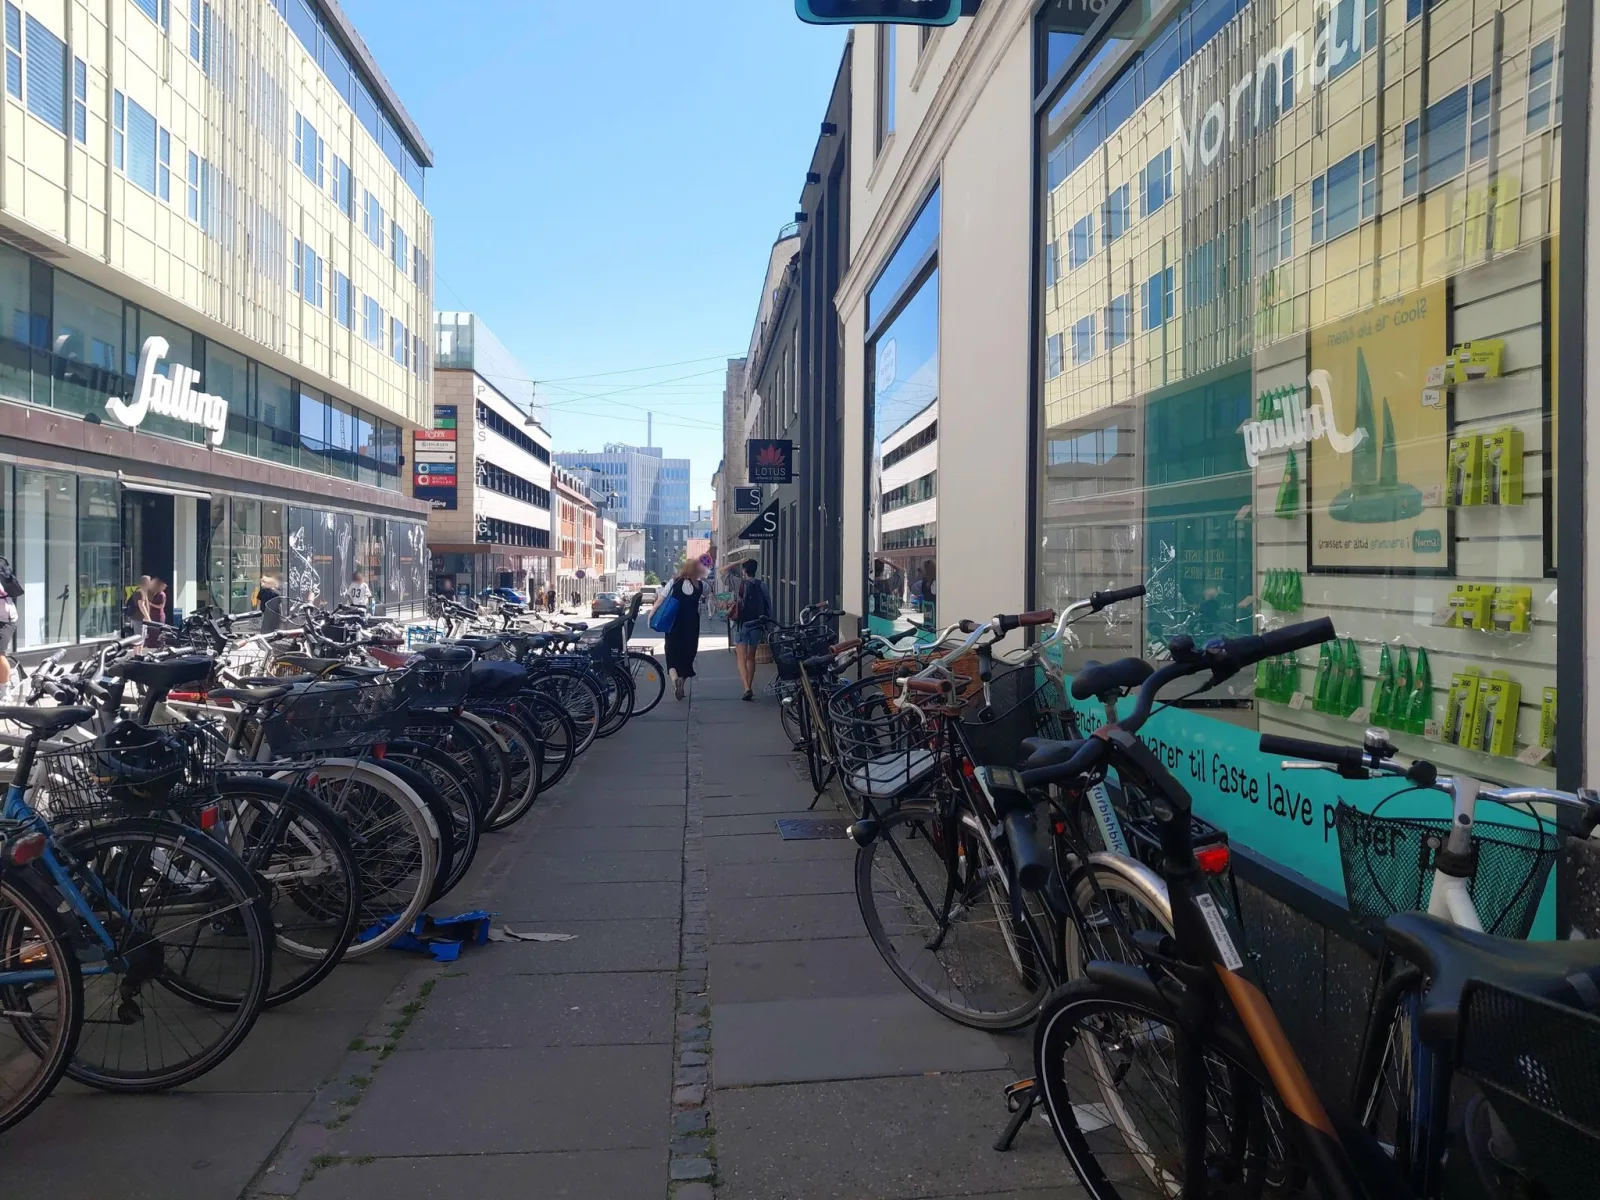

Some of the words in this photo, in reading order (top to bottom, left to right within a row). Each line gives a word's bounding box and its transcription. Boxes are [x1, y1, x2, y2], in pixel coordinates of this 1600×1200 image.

[1174, 0, 1365, 176] Normal
[1327, 326, 1354, 347] mens
[1375, 315, 1389, 332] er
[105, 336, 229, 446] Salling
[756, 467, 786, 476] LOTUS
[750, 489, 761, 506] S
[764, 512, 777, 532] S
[1353, 537, 1369, 550] altid
[1415, 535, 1439, 548] Normal
[255, 553, 282, 568] ARHUS
[351, 587, 362, 599] 03
[1460, 679, 1471, 687] 360
[1490, 684, 1502, 692] 360
[1072, 705, 1102, 733] endte
[1189, 749, 1206, 784] til
[1212, 753, 1260, 804] faste
[1266, 772, 1314, 827] lave
[1324, 803, 1406, 861] piser
